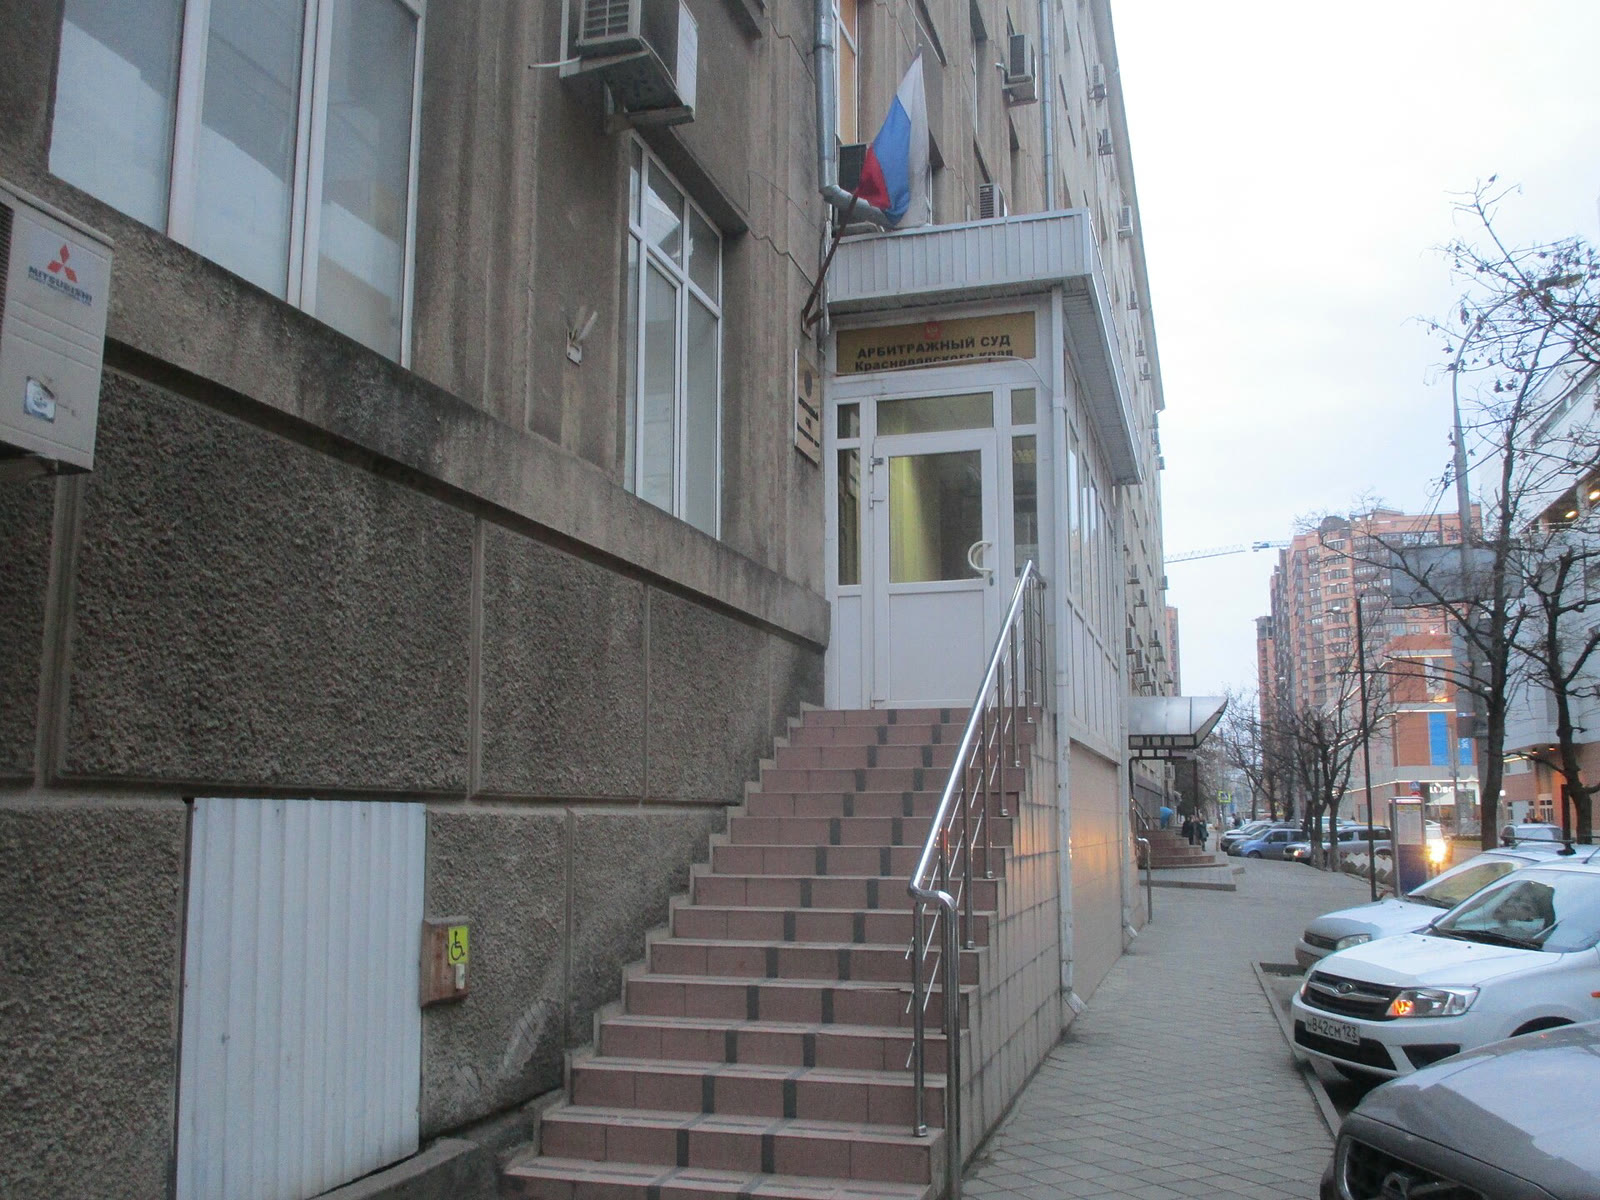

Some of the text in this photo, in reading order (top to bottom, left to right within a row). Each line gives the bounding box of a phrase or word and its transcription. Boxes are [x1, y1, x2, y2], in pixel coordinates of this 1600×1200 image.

[28, 265, 93, 303] MITSUBISHI
[857, 335, 1011, 359] АРБИТРАЖНЫЙ СУД
